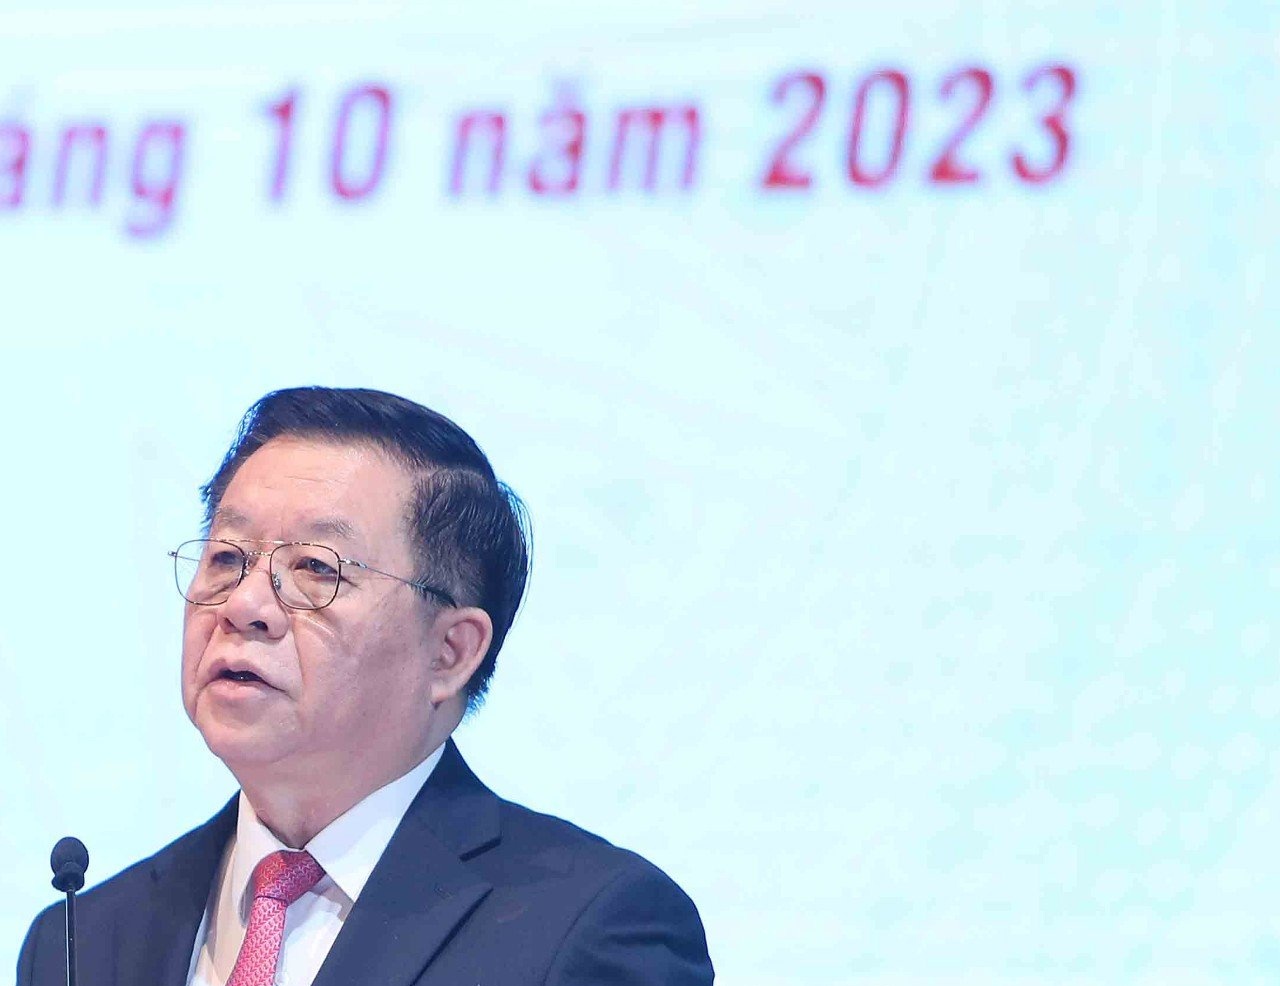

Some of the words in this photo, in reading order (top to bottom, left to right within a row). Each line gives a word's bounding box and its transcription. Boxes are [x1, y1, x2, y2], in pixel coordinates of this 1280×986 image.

[260, 82, 396, 204] 10
[446, 72, 704, 198] năm
[758, 60, 1082, 192] 2023
